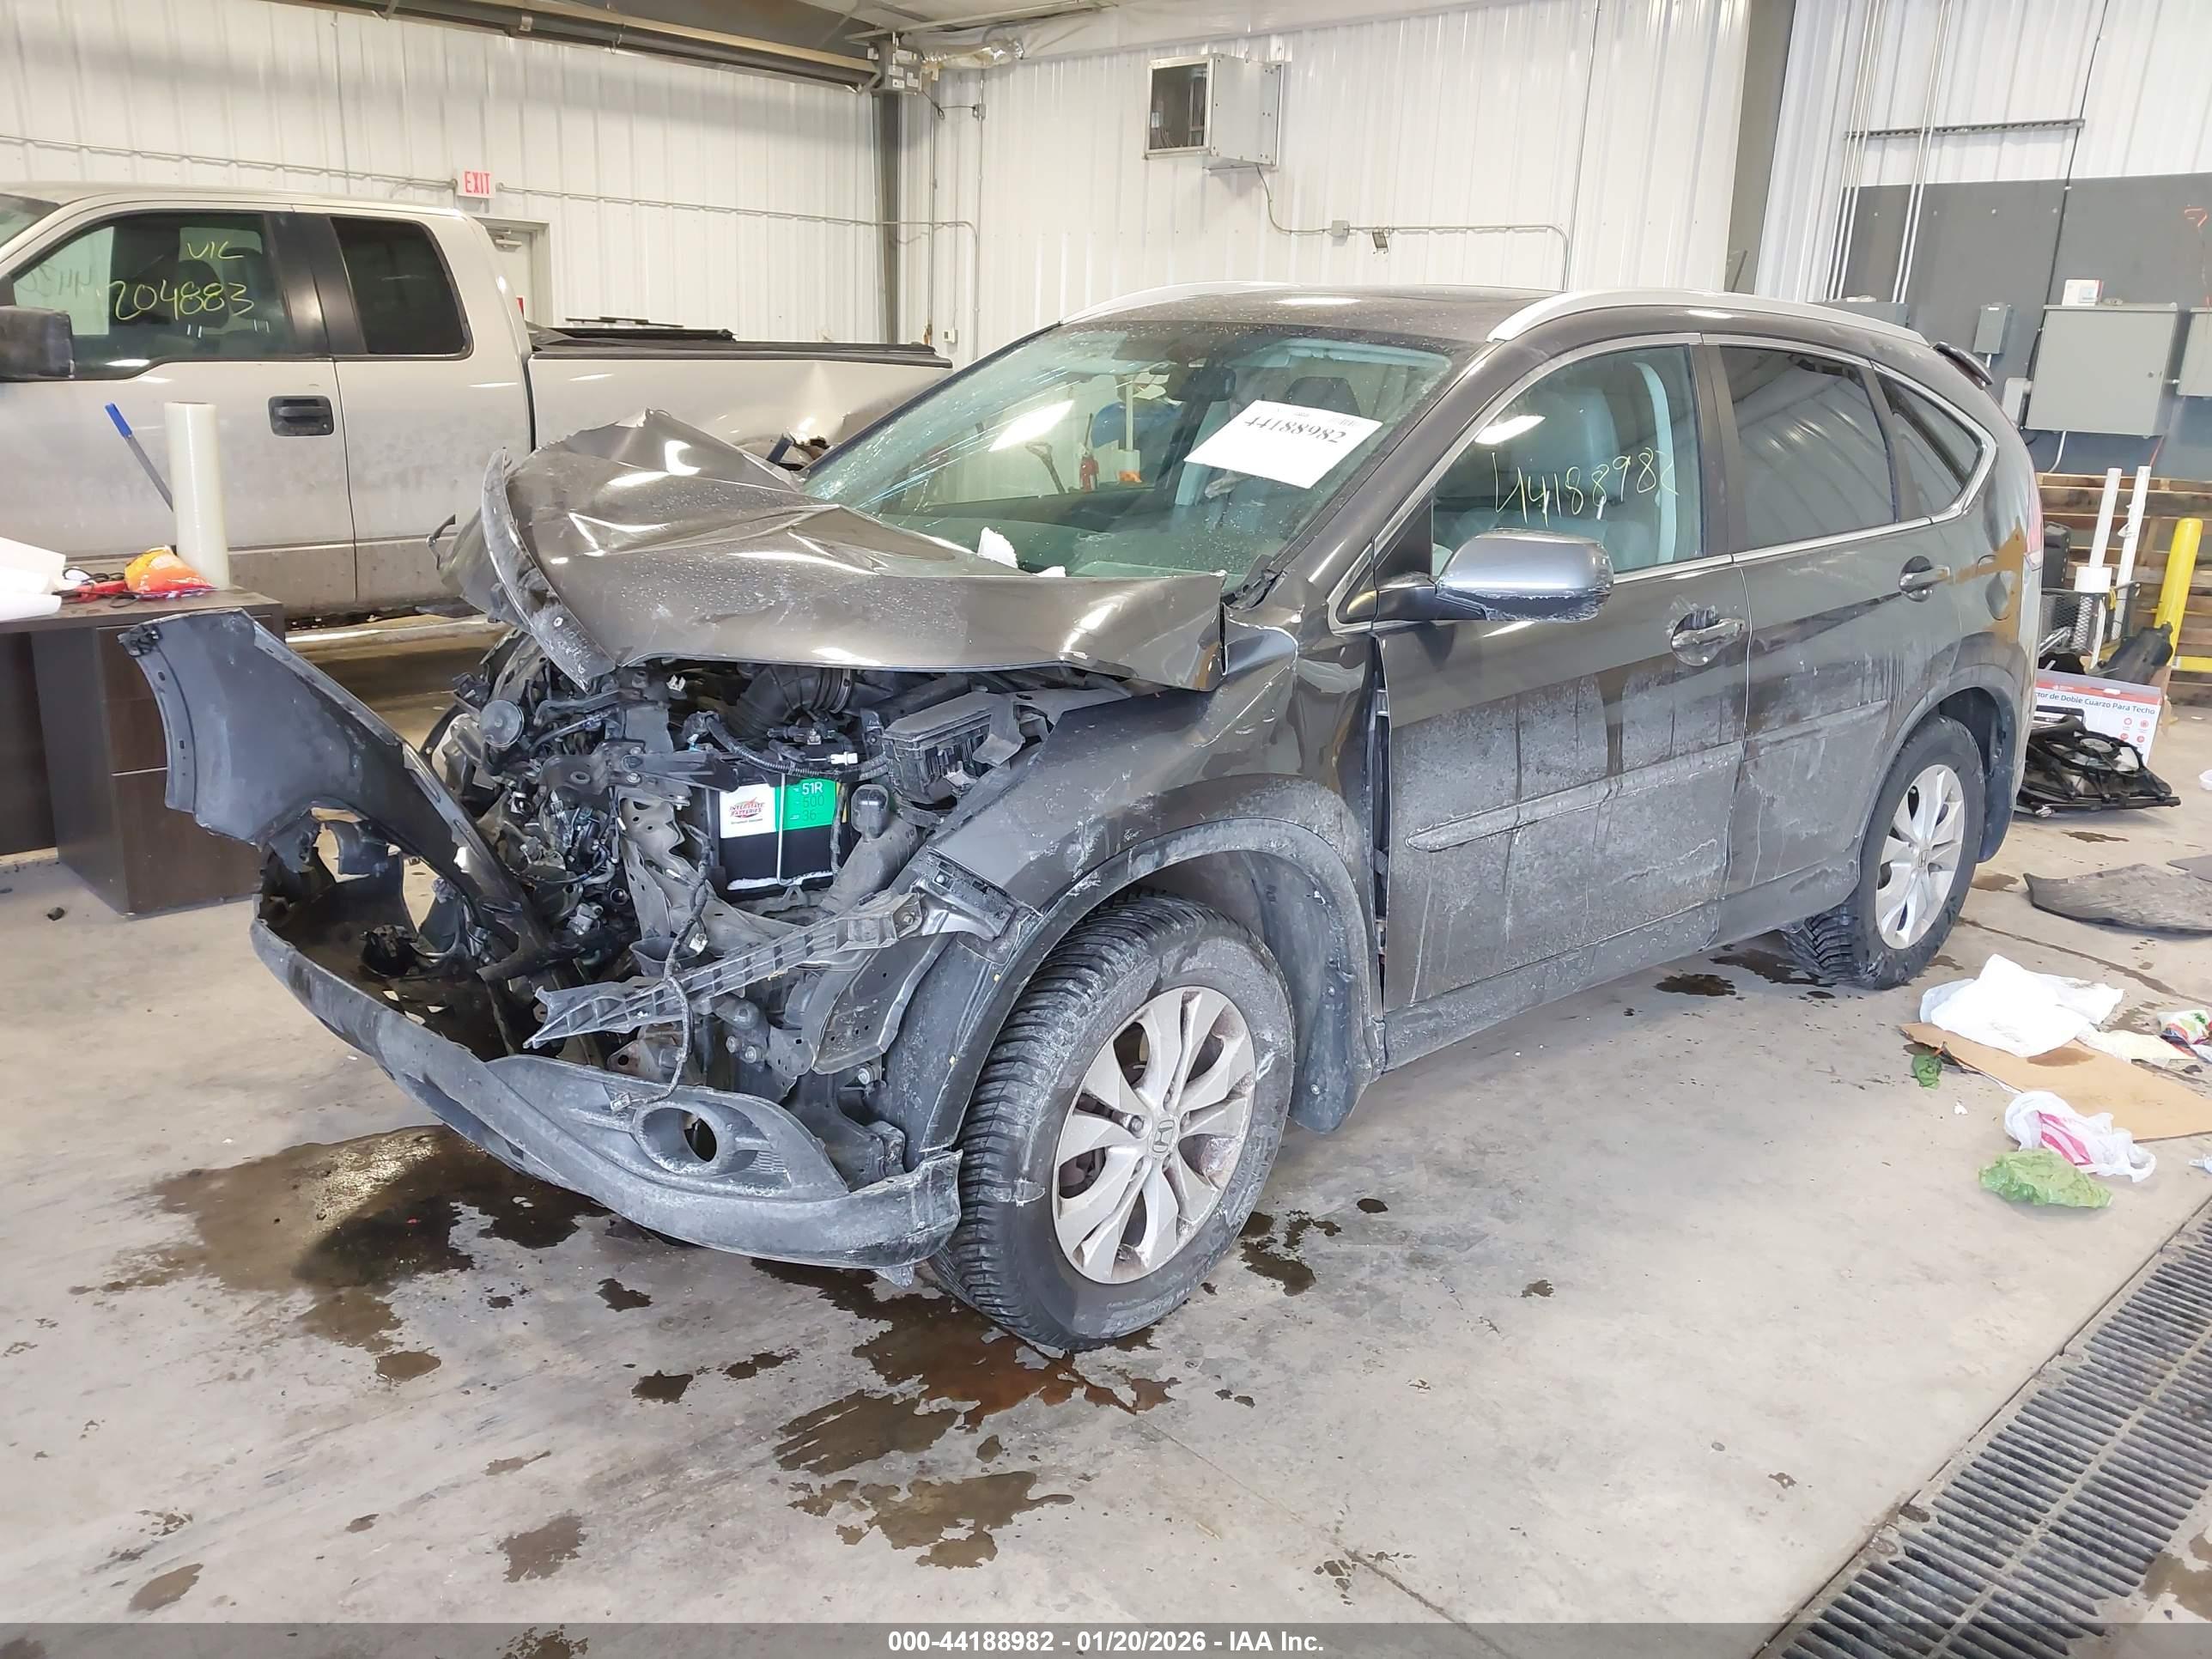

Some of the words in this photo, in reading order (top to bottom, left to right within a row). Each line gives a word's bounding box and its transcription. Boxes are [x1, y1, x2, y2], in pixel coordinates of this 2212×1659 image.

[465, 171, 490, 194] EXIT
[1243, 416, 1347, 444] 44188982
[2061, 695, 2083, 704] Doble
[2084, 698, 2111, 708] Cuarzo
[2112, 702, 2130, 711] Para
[2132, 705, 2155, 714] Techo
[802, 781, 823, 795] 51R
[803, 795, 825, 809] 500
[802, 809, 817, 822] 36
